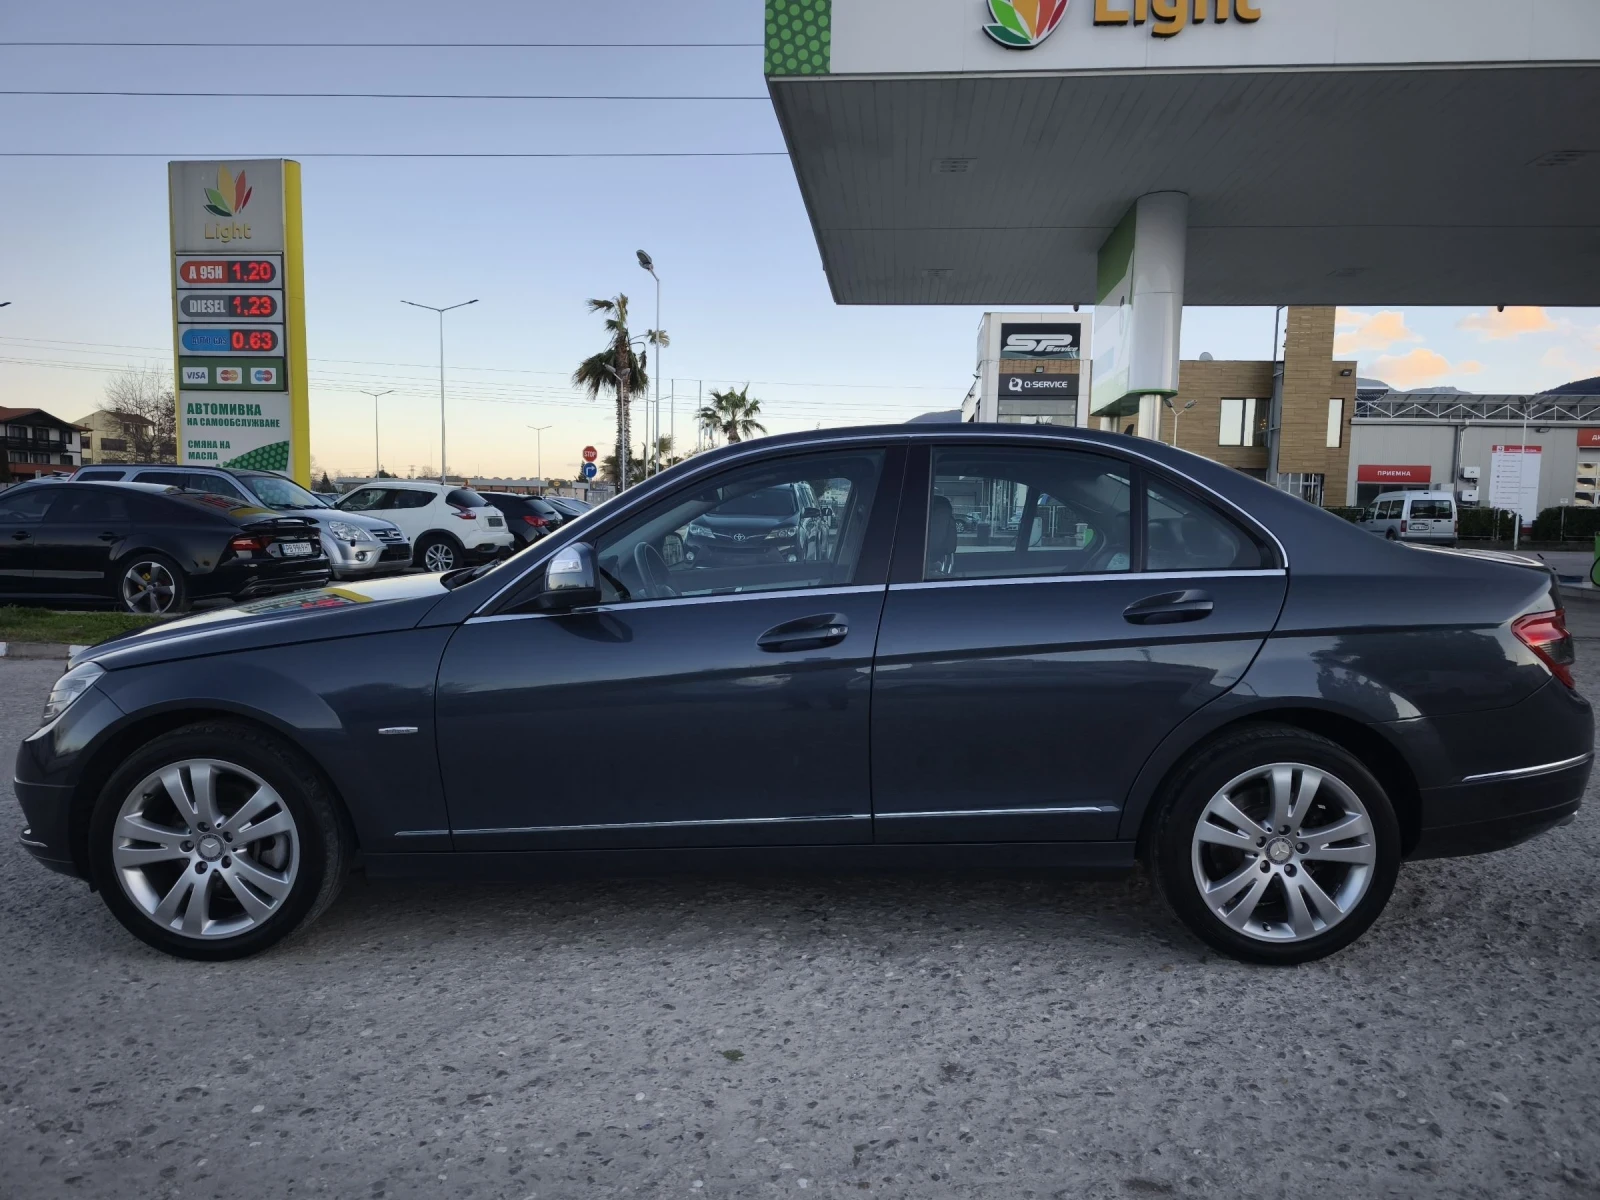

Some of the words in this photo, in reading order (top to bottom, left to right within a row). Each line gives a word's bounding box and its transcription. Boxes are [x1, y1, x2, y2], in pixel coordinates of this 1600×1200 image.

[204, 222, 252, 243] Light
[189, 266, 197, 279] A
[190, 300, 225, 313] DIESEL
[1002, 334, 1073, 351] SP
[187, 371, 206, 380] VISA
[186, 403, 262, 416] АВТОМИВКА
[186, 418, 198, 426] НА
[200, 418, 280, 428] САМООБСЛУЖВАНЕ
[187, 440, 218, 449] СМЯНА
[219, 441, 231, 449] НА
[188, 452, 218, 460] МАСЛА
